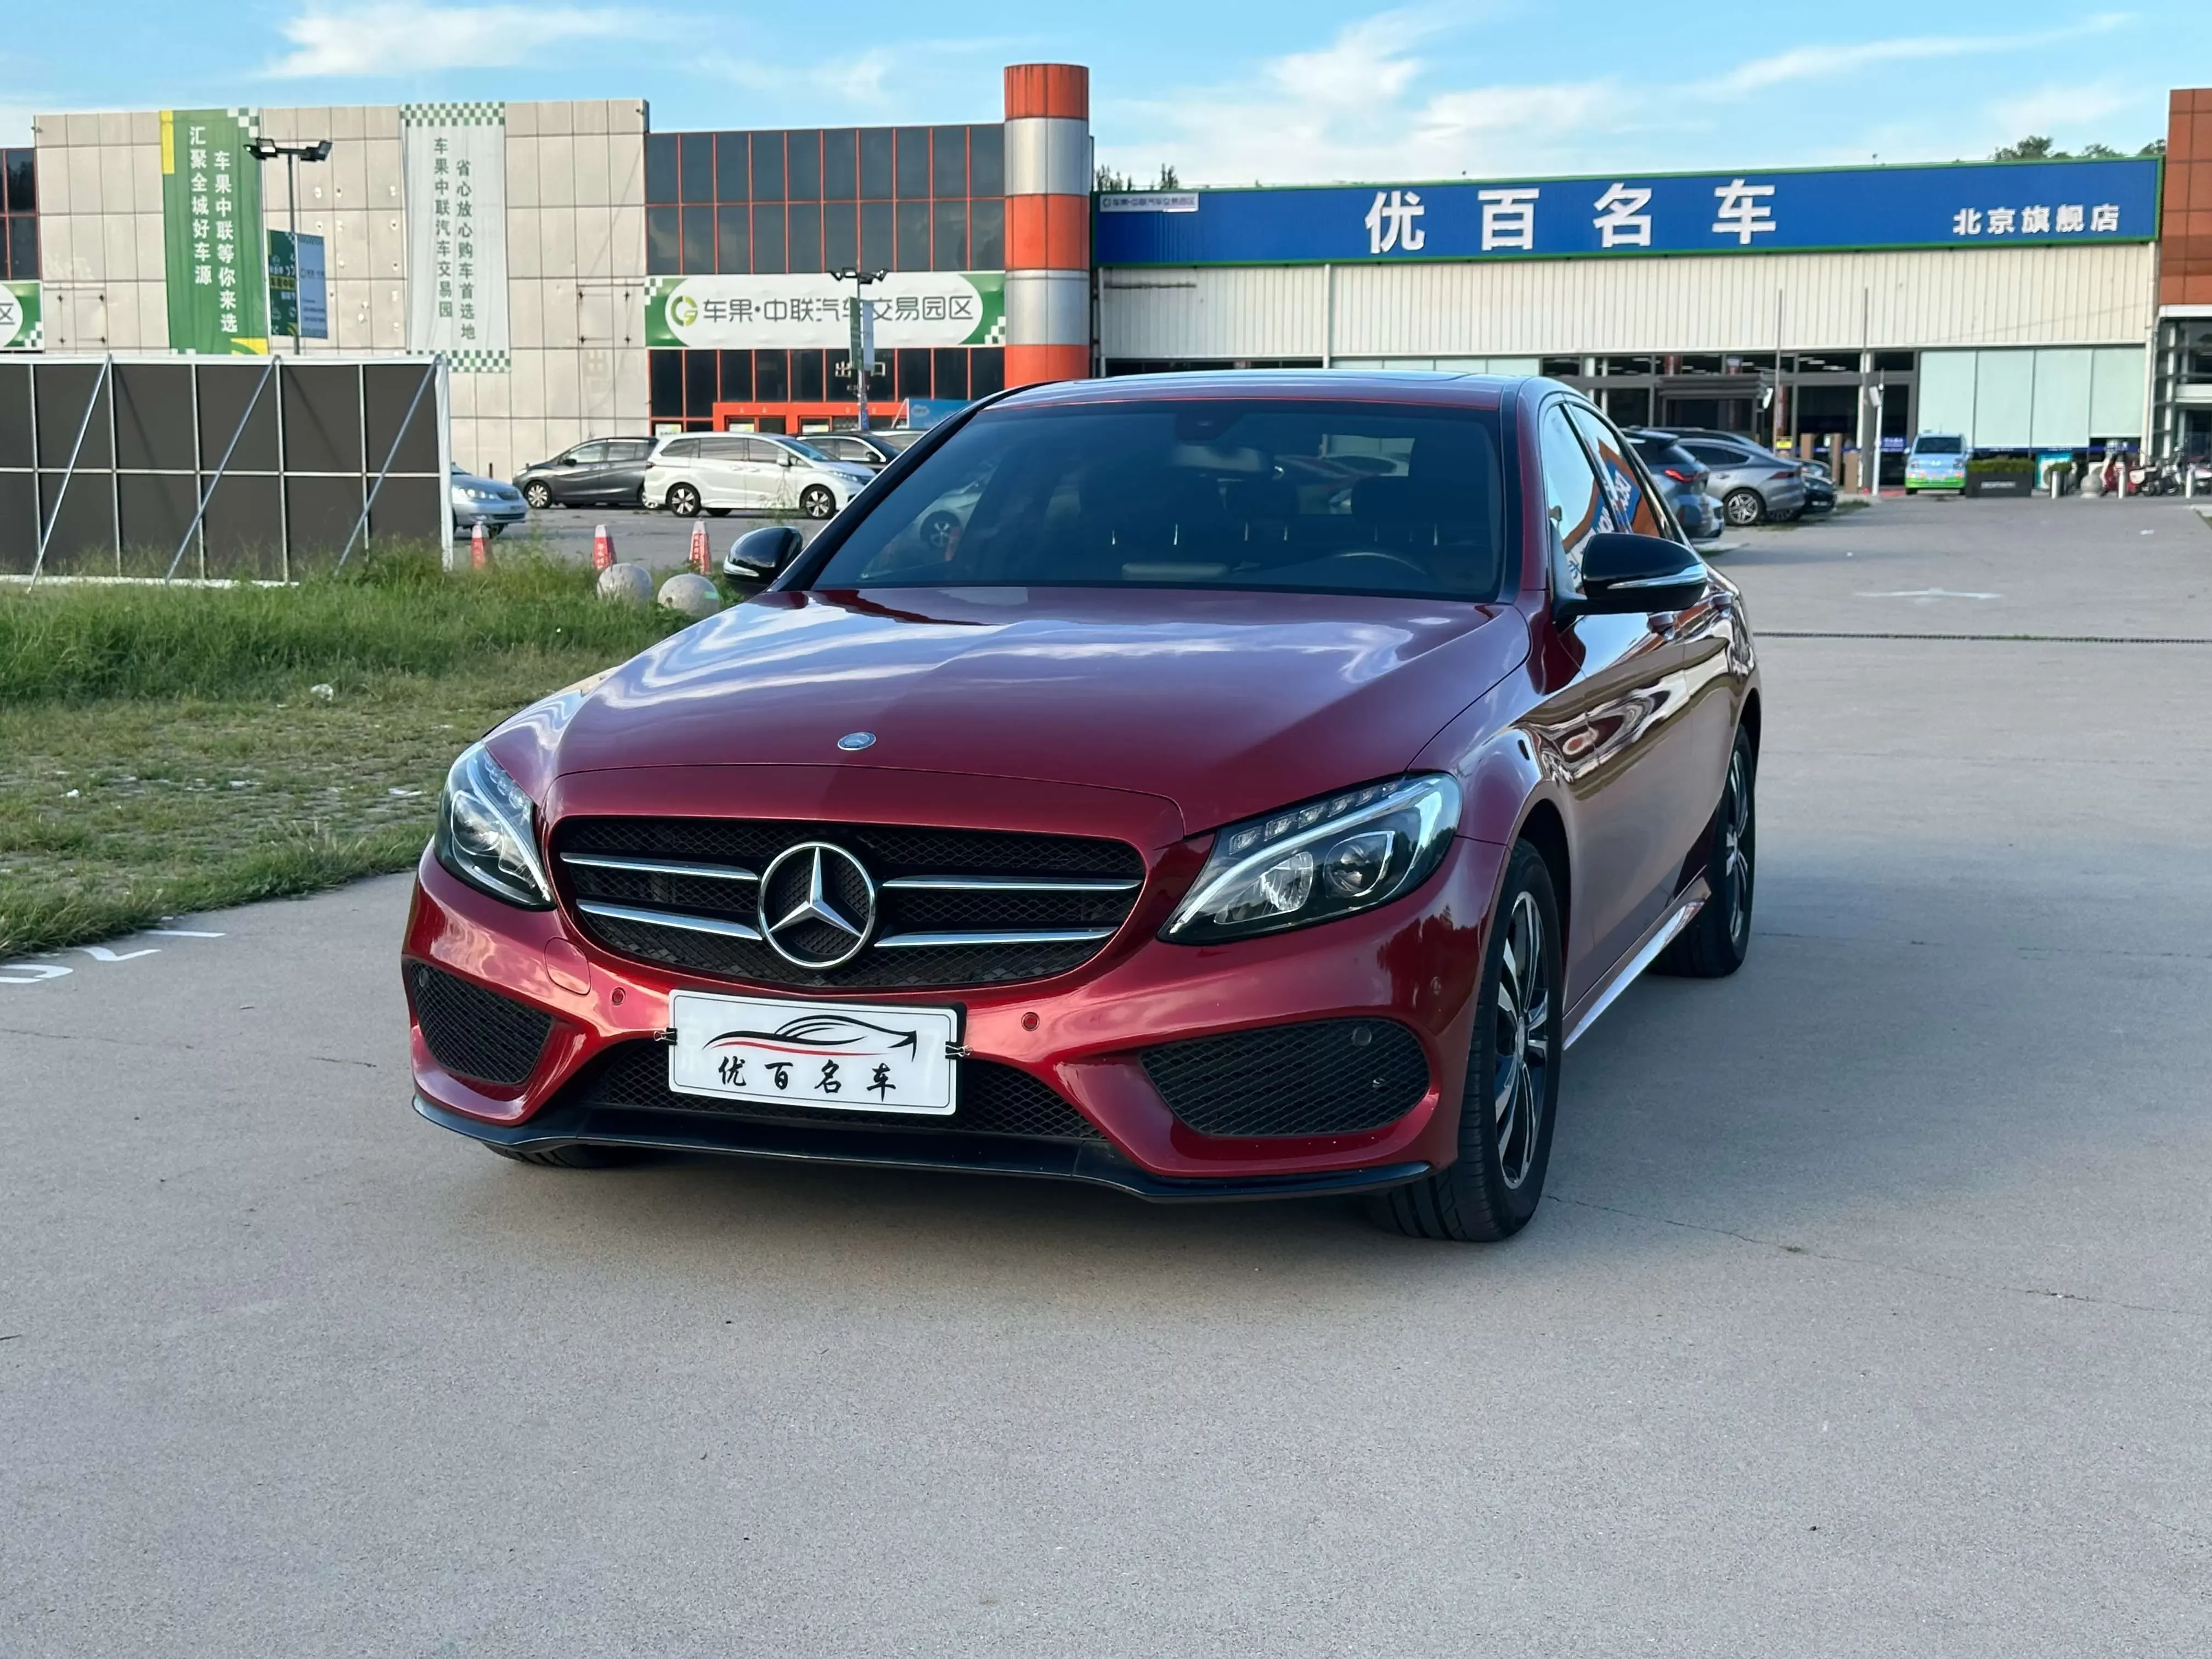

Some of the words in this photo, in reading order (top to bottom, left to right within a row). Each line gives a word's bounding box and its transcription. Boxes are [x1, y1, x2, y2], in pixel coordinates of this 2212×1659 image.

[189, 126, 212, 285] 汇聚全城好车源
[214, 151, 238, 333] 车果中联等你来选
[456, 160, 476, 340] 省心放心购车首选地
[1364, 179, 1776, 254] 优百名车
[1953, 203, 2120, 235] 北京旗舰店
[718, 1055, 896, 1102] 优百名车
